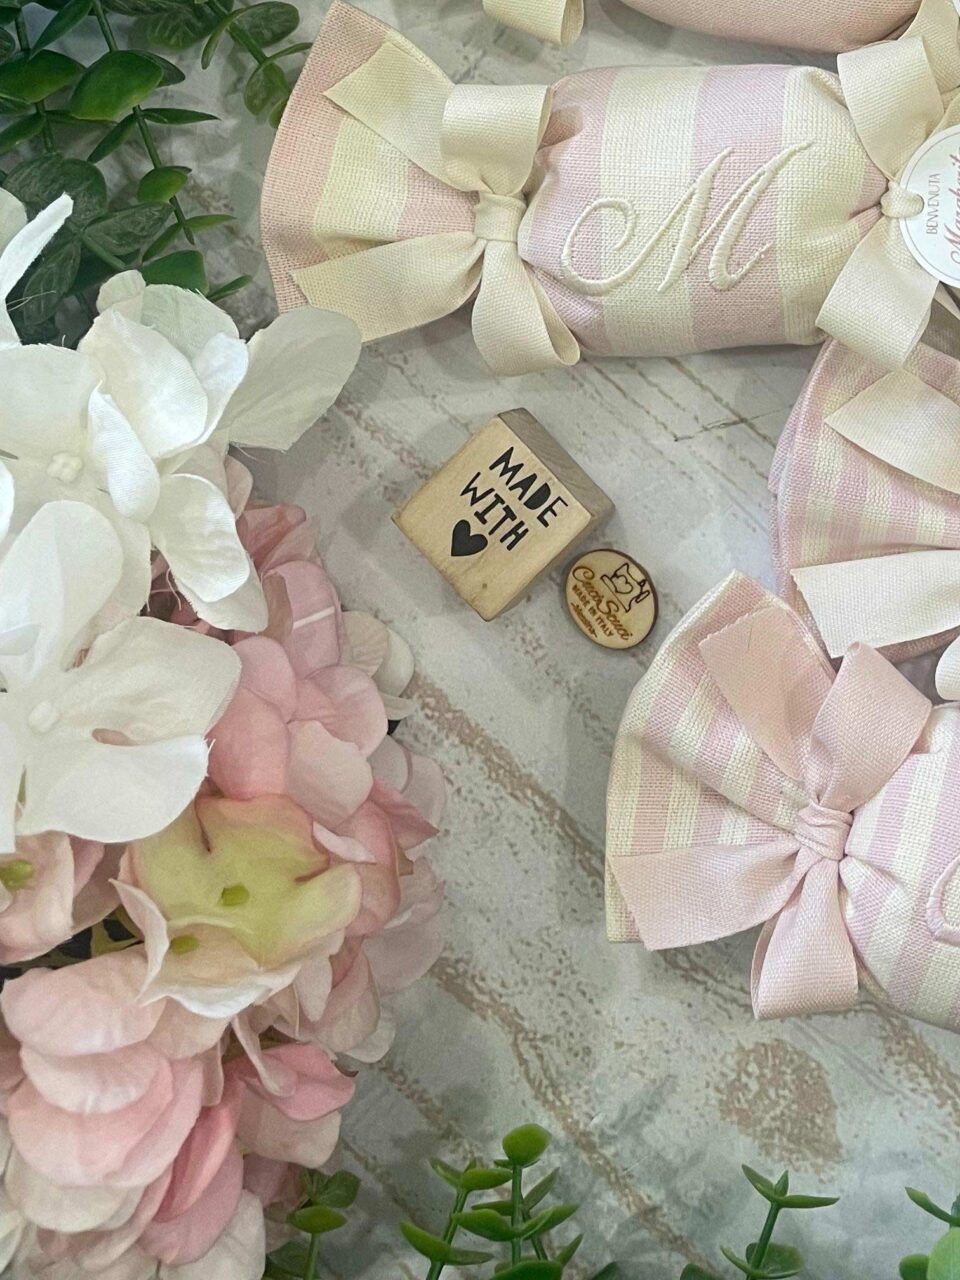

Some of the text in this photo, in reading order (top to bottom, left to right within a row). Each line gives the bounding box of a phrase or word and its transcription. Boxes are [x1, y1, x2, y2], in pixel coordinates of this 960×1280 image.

[560, 141, 815, 295] M
[926, 172, 942, 235] BENVENUTA
[459, 471, 529, 551] WITH
[488, 446, 568, 528] MADE
[572, 584, 615, 637] MADE IN ITALY
